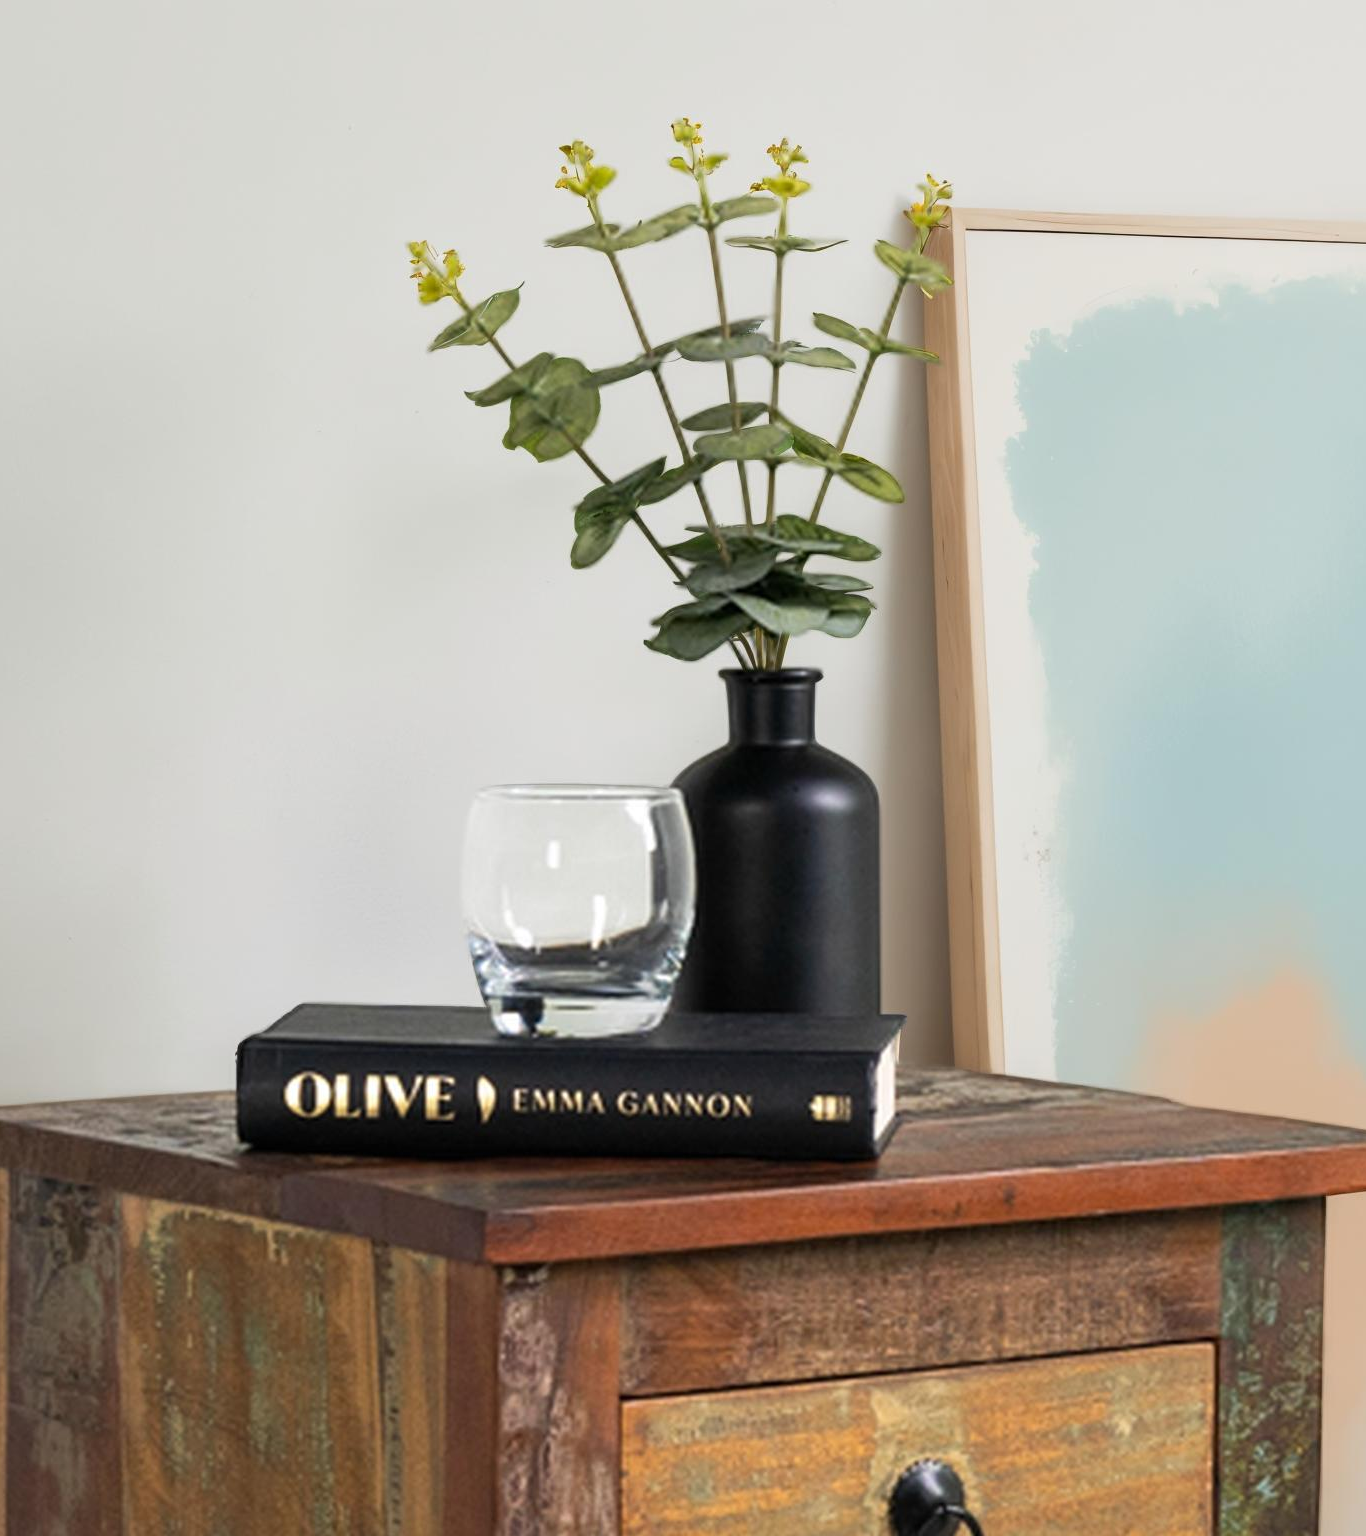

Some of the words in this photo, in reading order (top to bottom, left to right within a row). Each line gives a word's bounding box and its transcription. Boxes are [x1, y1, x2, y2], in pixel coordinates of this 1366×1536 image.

[283, 1070, 457, 1121] OLIVE
[512, 1087, 606, 1114] EMMA
[616, 1091, 754, 1118] GANNON
